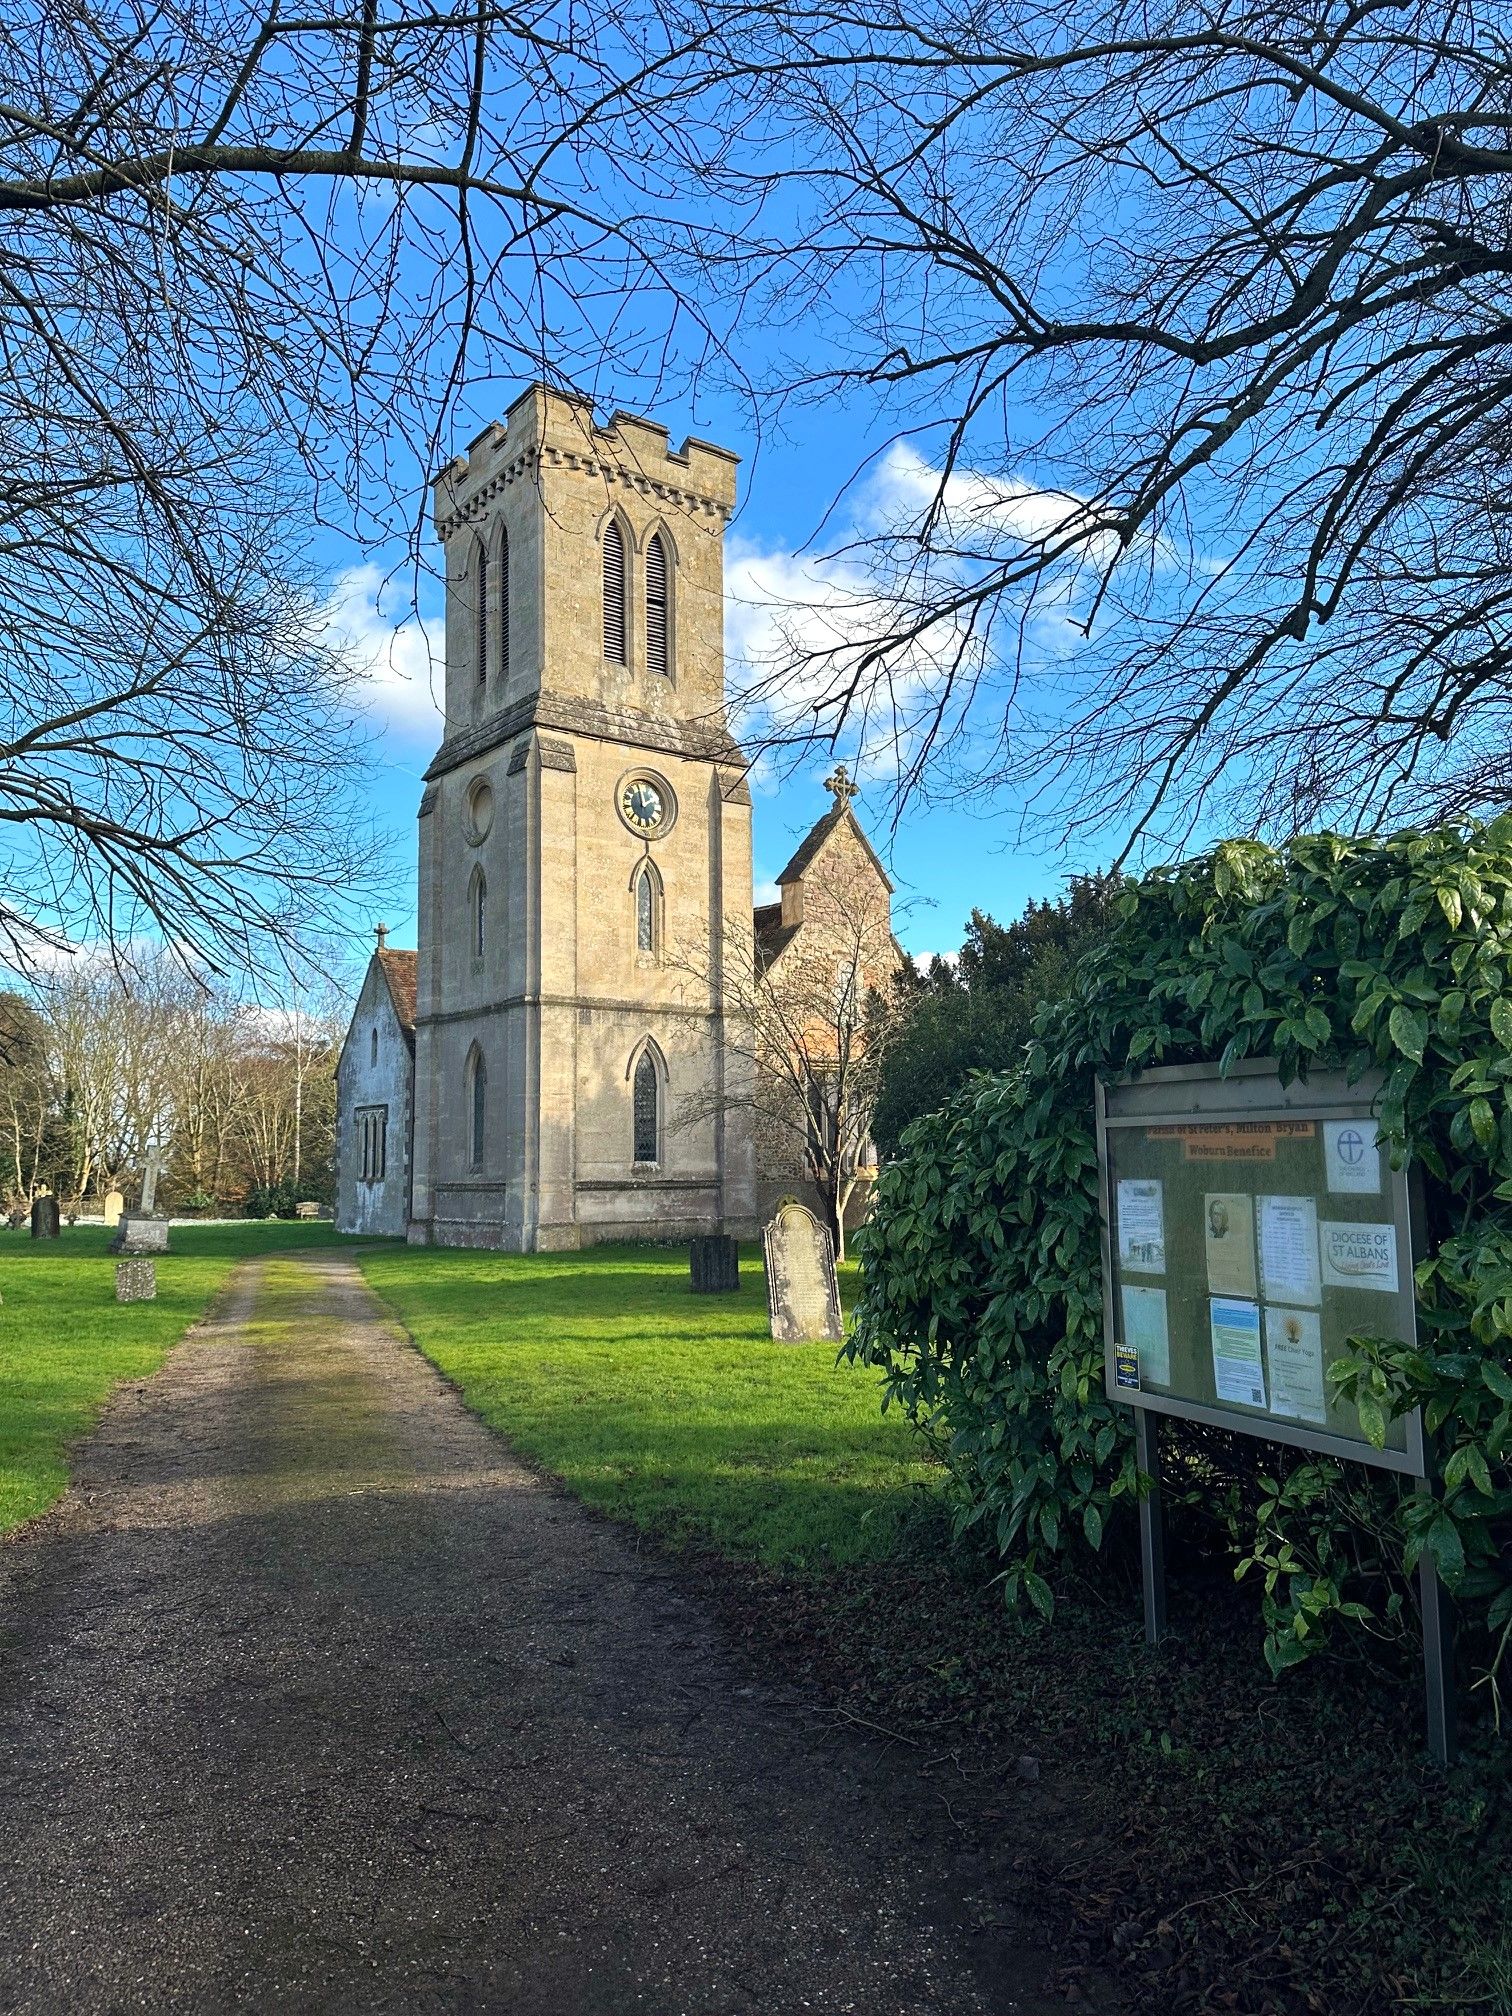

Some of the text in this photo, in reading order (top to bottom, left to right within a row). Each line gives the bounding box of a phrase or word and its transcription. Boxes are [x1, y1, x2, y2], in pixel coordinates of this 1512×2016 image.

[1236, 1122, 1272, 1134] Milton
[1275, 1121, 1309, 1135] Bryan
[1189, 1144, 1271, 1158] Woburn Benefice
[1332, 1232, 1388, 1246] DIOCESE OF
[1332, 1245, 1389, 1261] ST ALBANS
[1274, 1344, 1288, 1352] FREE
